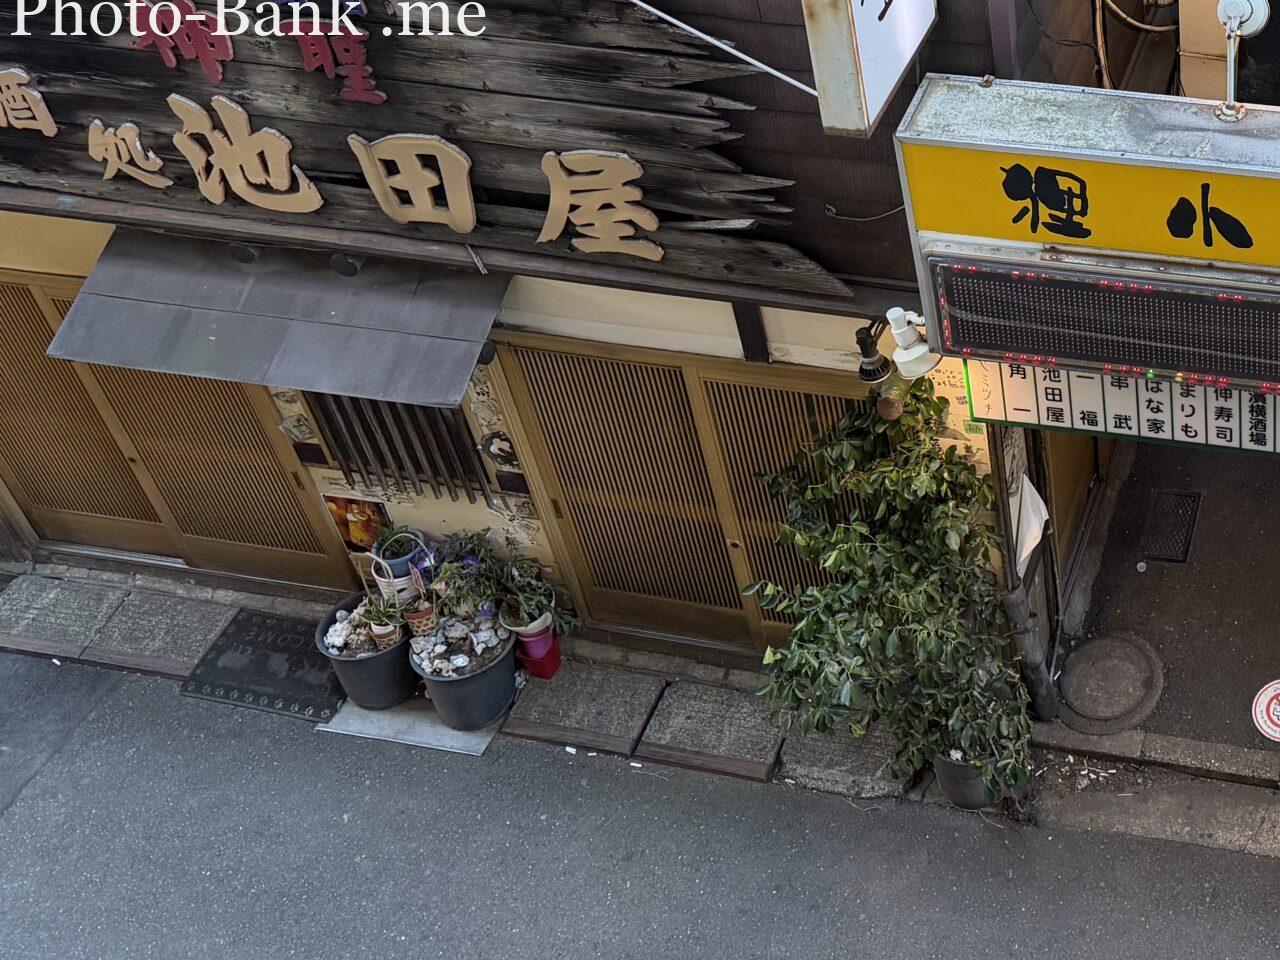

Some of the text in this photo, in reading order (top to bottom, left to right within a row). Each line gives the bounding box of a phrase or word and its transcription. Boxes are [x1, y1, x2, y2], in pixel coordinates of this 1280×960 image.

[1042, 367, 1066, 424] 池田屋
[1076, 374, 1099, 428] 一福
[1178, 383, 1200, 439] まりも
[1213, 387, 1234, 444] 伸寿司
